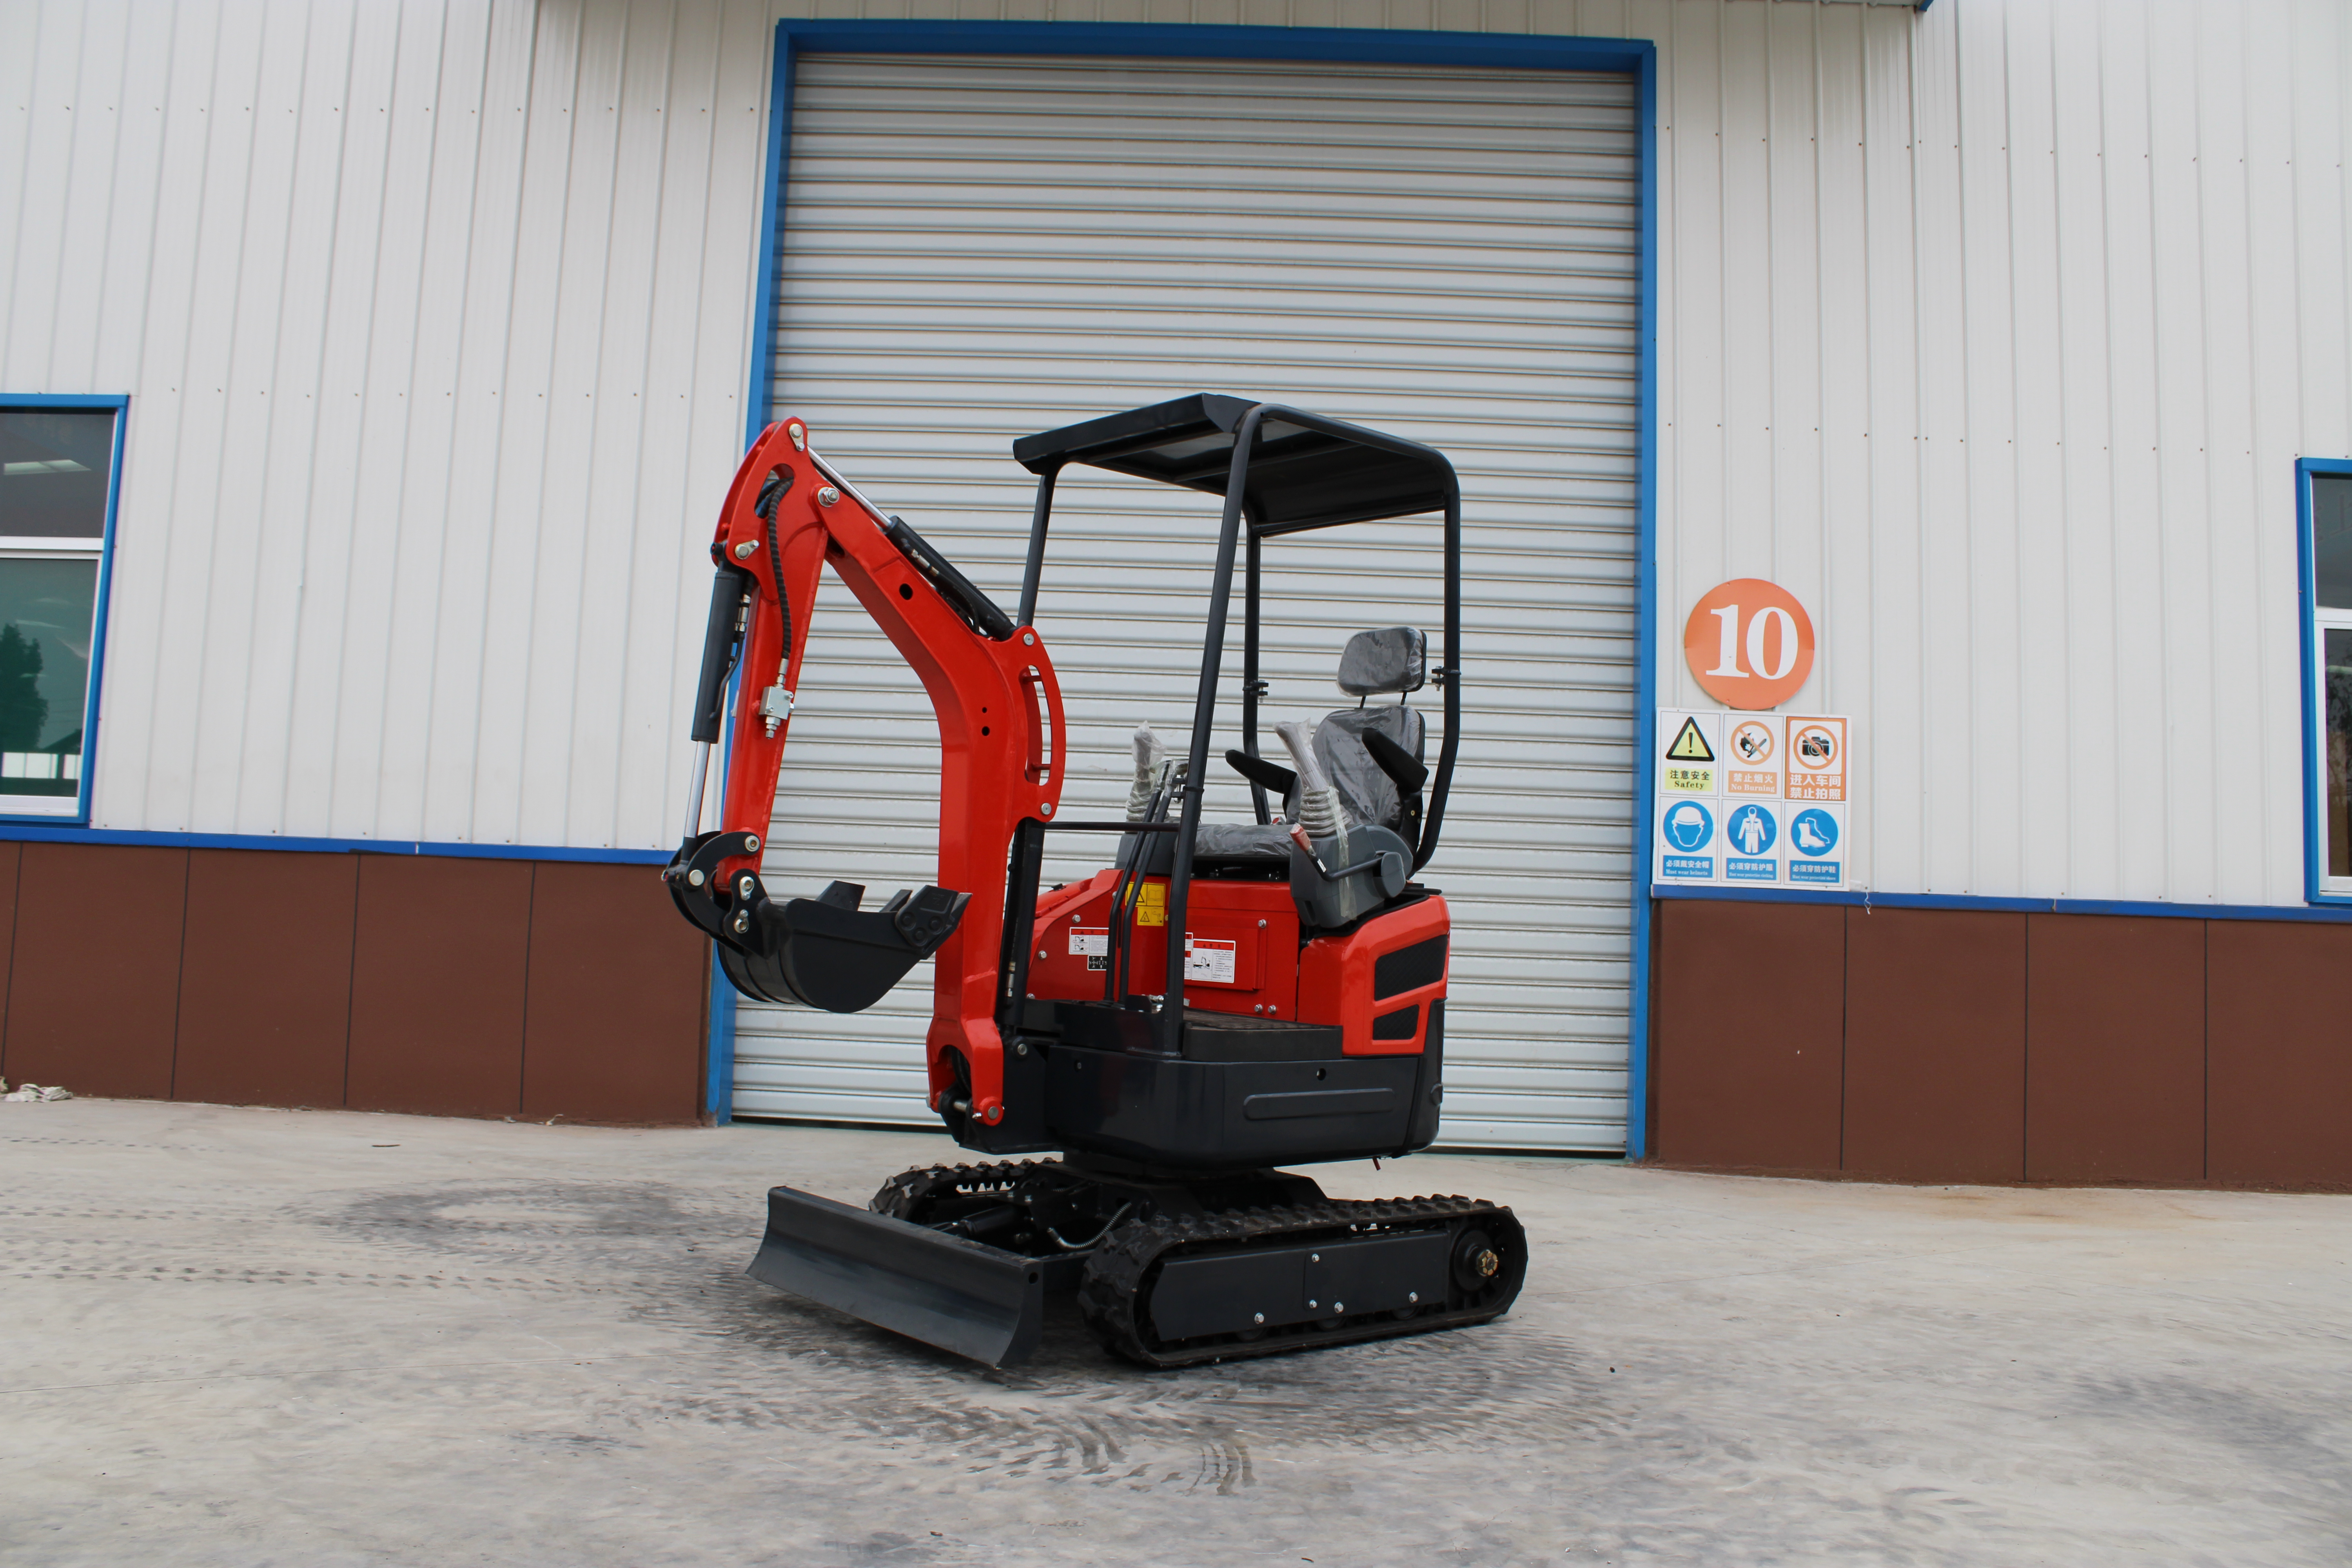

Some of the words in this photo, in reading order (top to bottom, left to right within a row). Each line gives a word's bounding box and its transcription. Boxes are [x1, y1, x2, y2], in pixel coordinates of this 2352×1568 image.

[1706, 604, 1798, 680] 10
[1670, 769, 1710, 780] 注意安全
[1733, 773, 1773, 783] 禁止烟火
[1674, 780, 1704, 789] Safety
[1744, 784, 1775, 793] Burning
[1789, 787, 1841, 800] 禁止拍照
[1666, 860, 1710, 868] 必须戴安全帽
[1729, 862, 1773, 871] 必须穿防护服
[1792, 865, 1836, 873] 必须穿防护鞋
